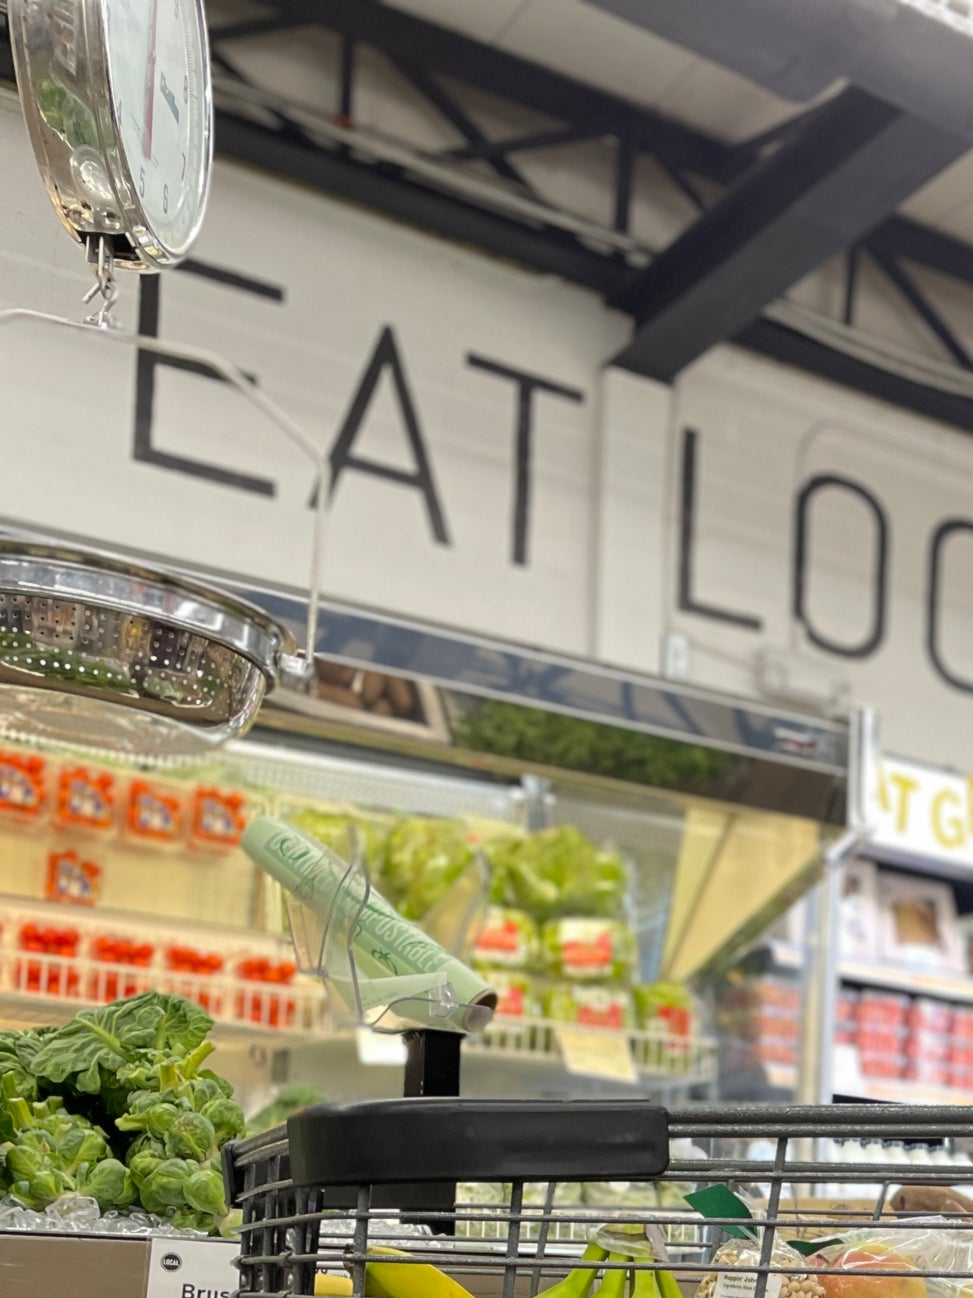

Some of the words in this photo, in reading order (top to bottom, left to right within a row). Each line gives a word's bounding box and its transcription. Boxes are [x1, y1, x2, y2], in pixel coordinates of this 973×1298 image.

[139, 165, 146, 199] 5
[162, 184, 169, 214] 6
[131, 256, 587, 568] EAT
[163, 1258, 179, 1266] LOCAL
